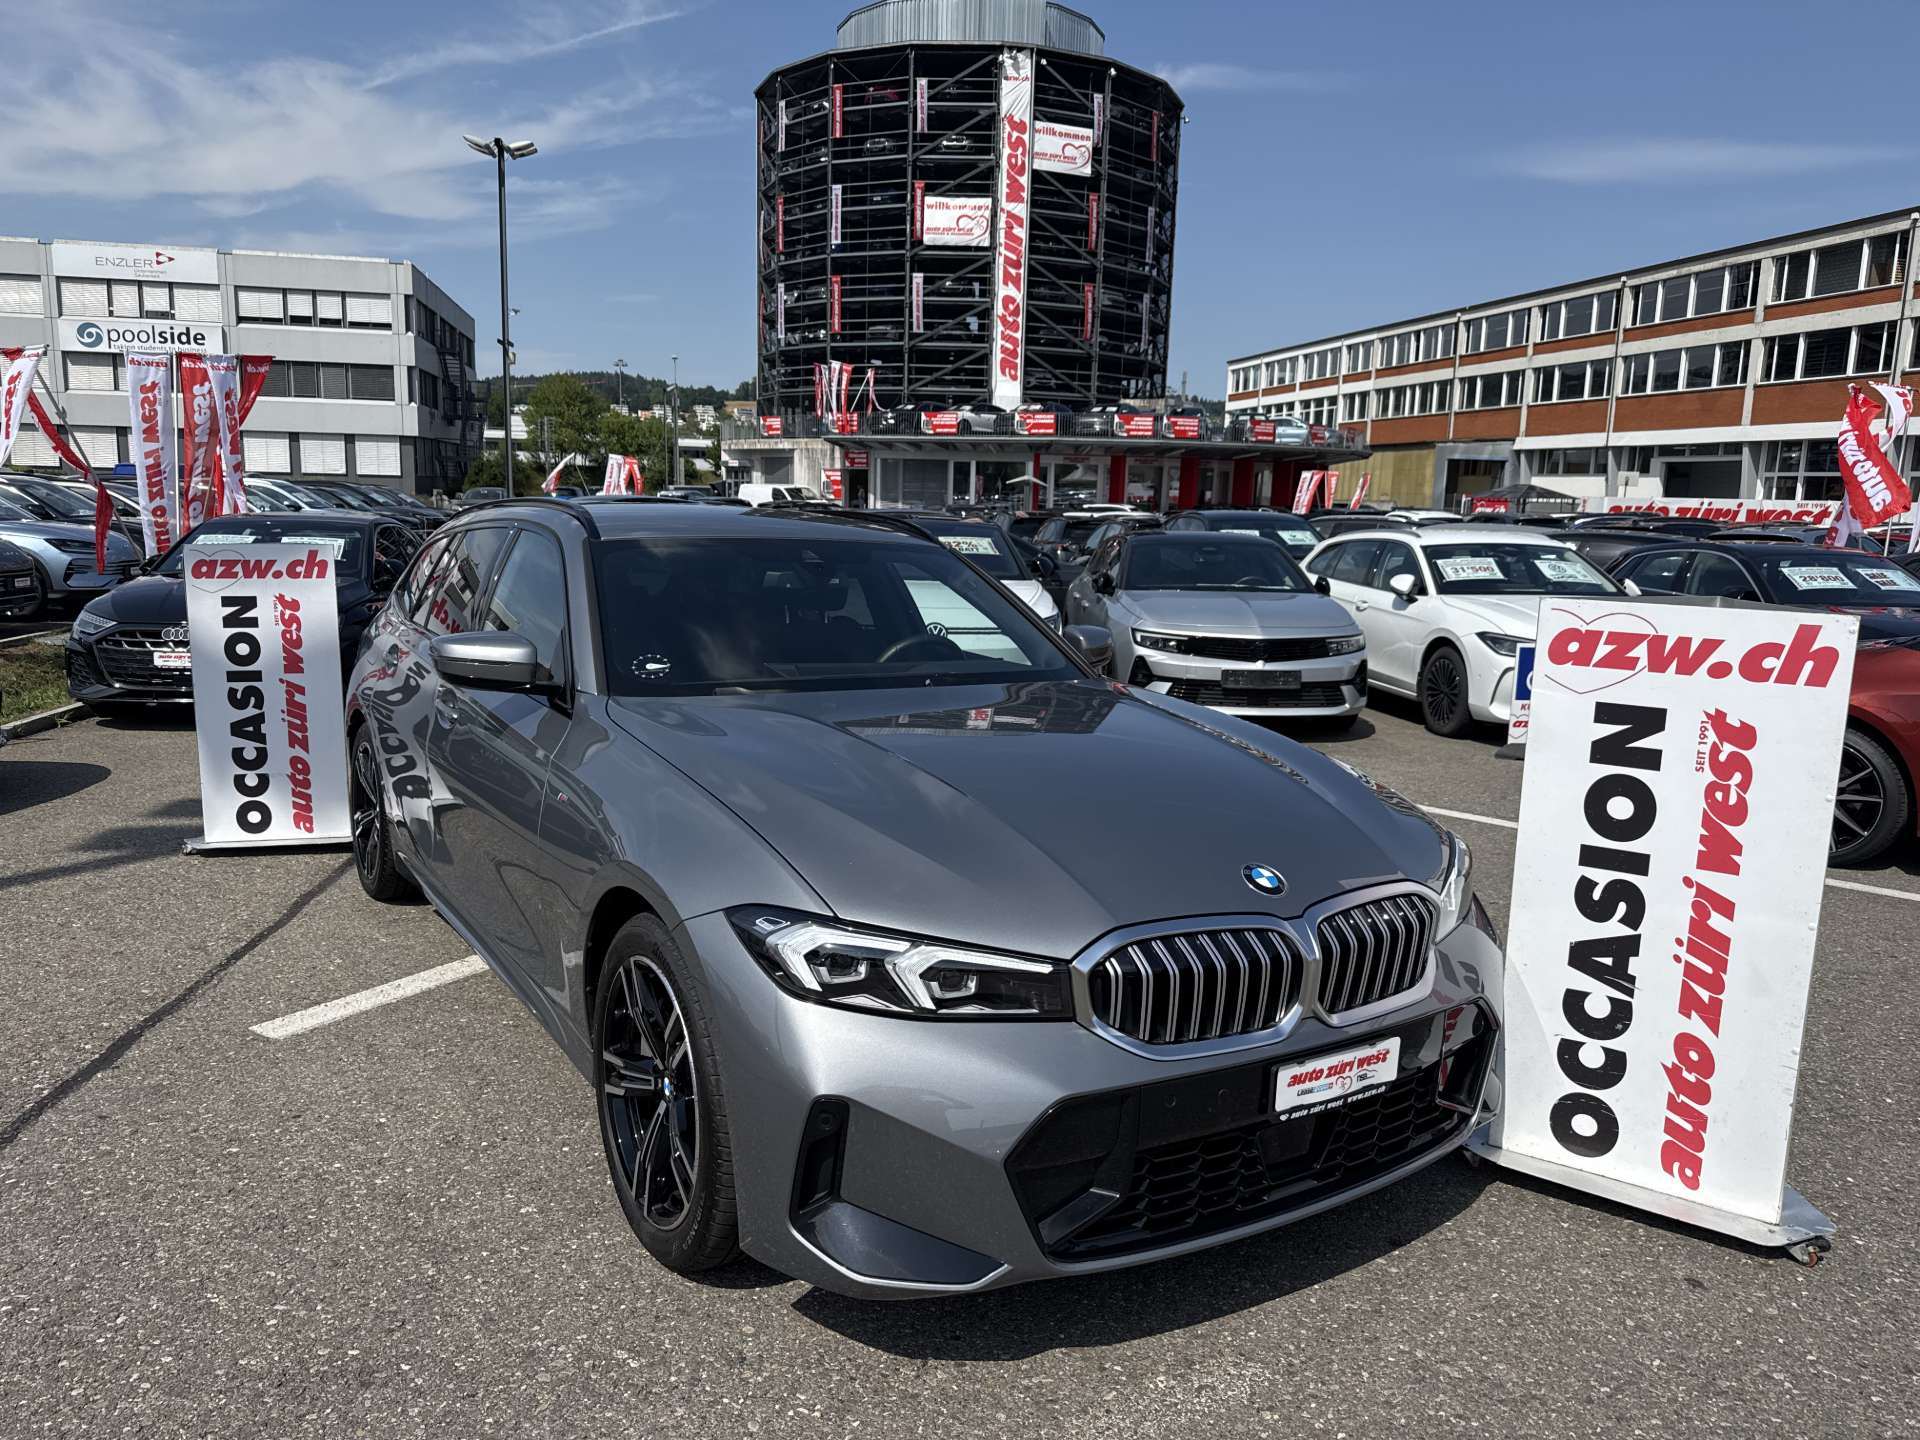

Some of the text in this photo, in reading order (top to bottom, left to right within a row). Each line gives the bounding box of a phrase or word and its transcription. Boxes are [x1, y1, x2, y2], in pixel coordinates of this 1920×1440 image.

[1034, 126, 1091, 142] willkommen
[95, 256, 154, 268] ENZLER
[997, 113, 1028, 382] auto züri west
[107, 325, 206, 349] poolside
[137, 344, 167, 352] students
[191, 549, 329, 580] azw.ch
[1547, 623, 1839, 689] azw.ch
[221, 595, 272, 834] OCCASION
[275, 592, 314, 834] auto züri west
[1694, 719, 1710, 774] SEIT 1991
[1549, 701, 1669, 1157] OCCASION
[1660, 707, 1758, 1191] auto züri west
[1286, 1048, 1391, 1088] auto züri west
